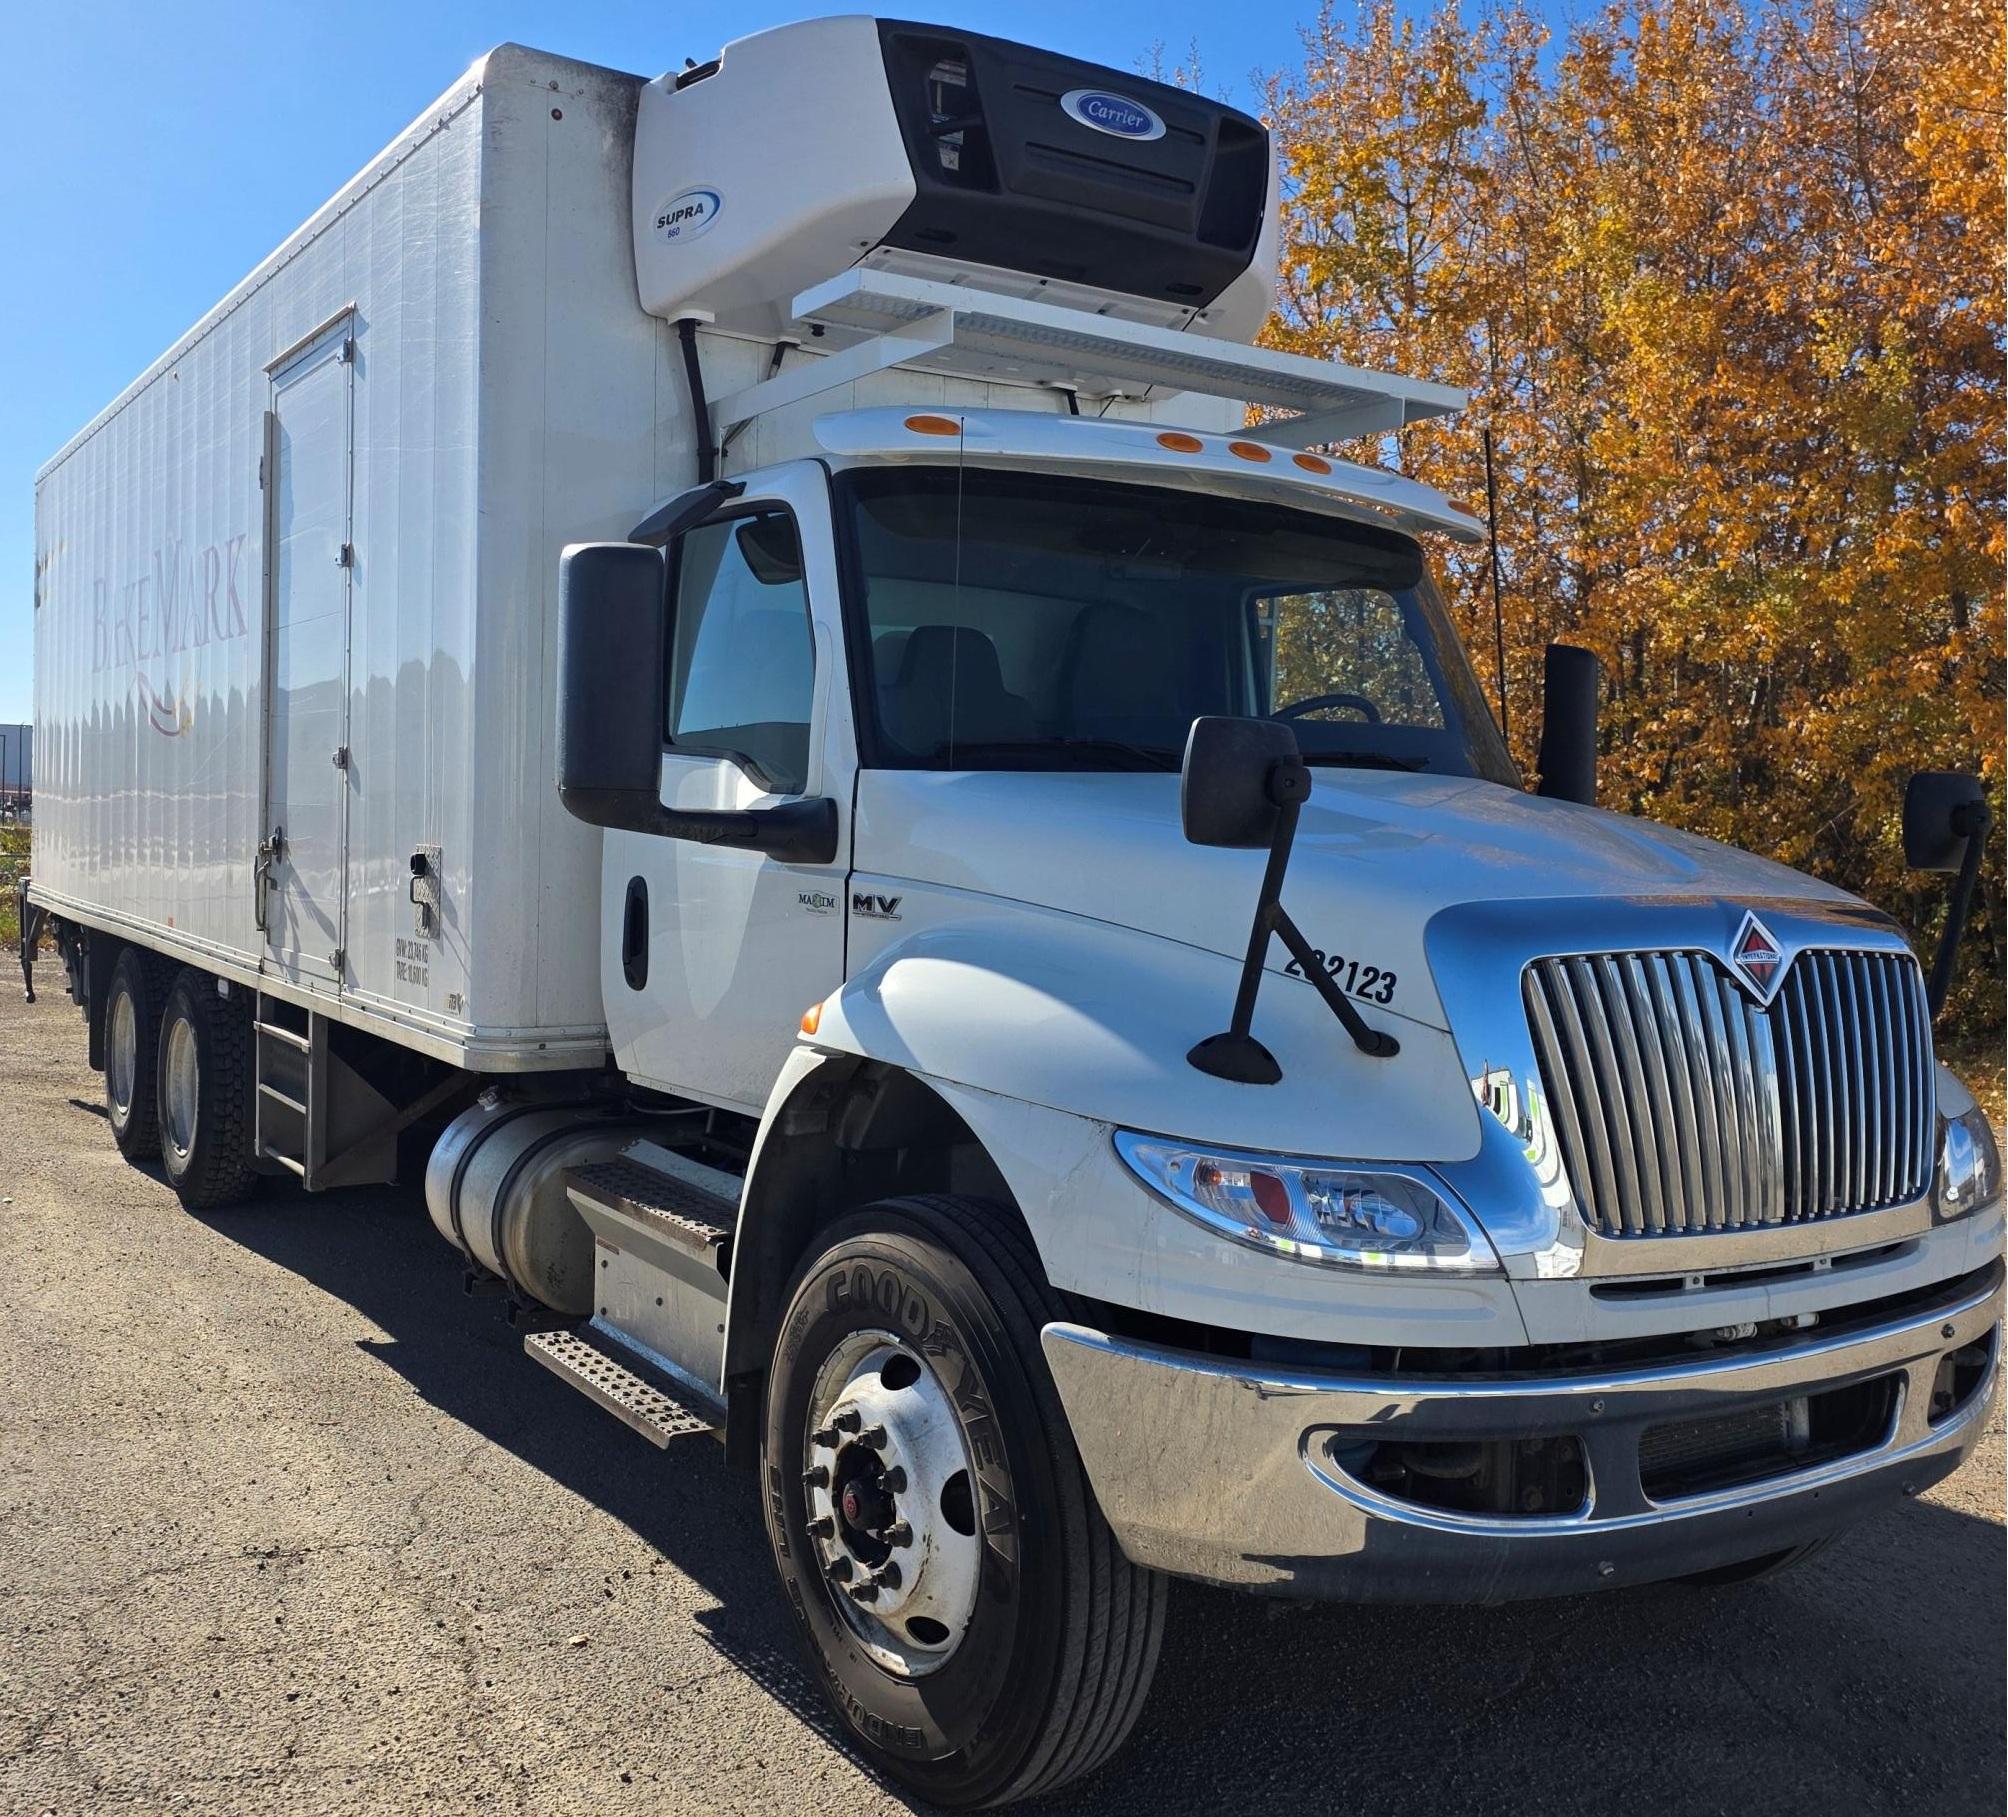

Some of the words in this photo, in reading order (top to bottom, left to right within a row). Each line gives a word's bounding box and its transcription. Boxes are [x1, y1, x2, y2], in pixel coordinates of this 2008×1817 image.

[1088, 101, 1143, 127] Carrier
[657, 203, 703, 229] SUPRA
[853, 893, 902, 914] MV
